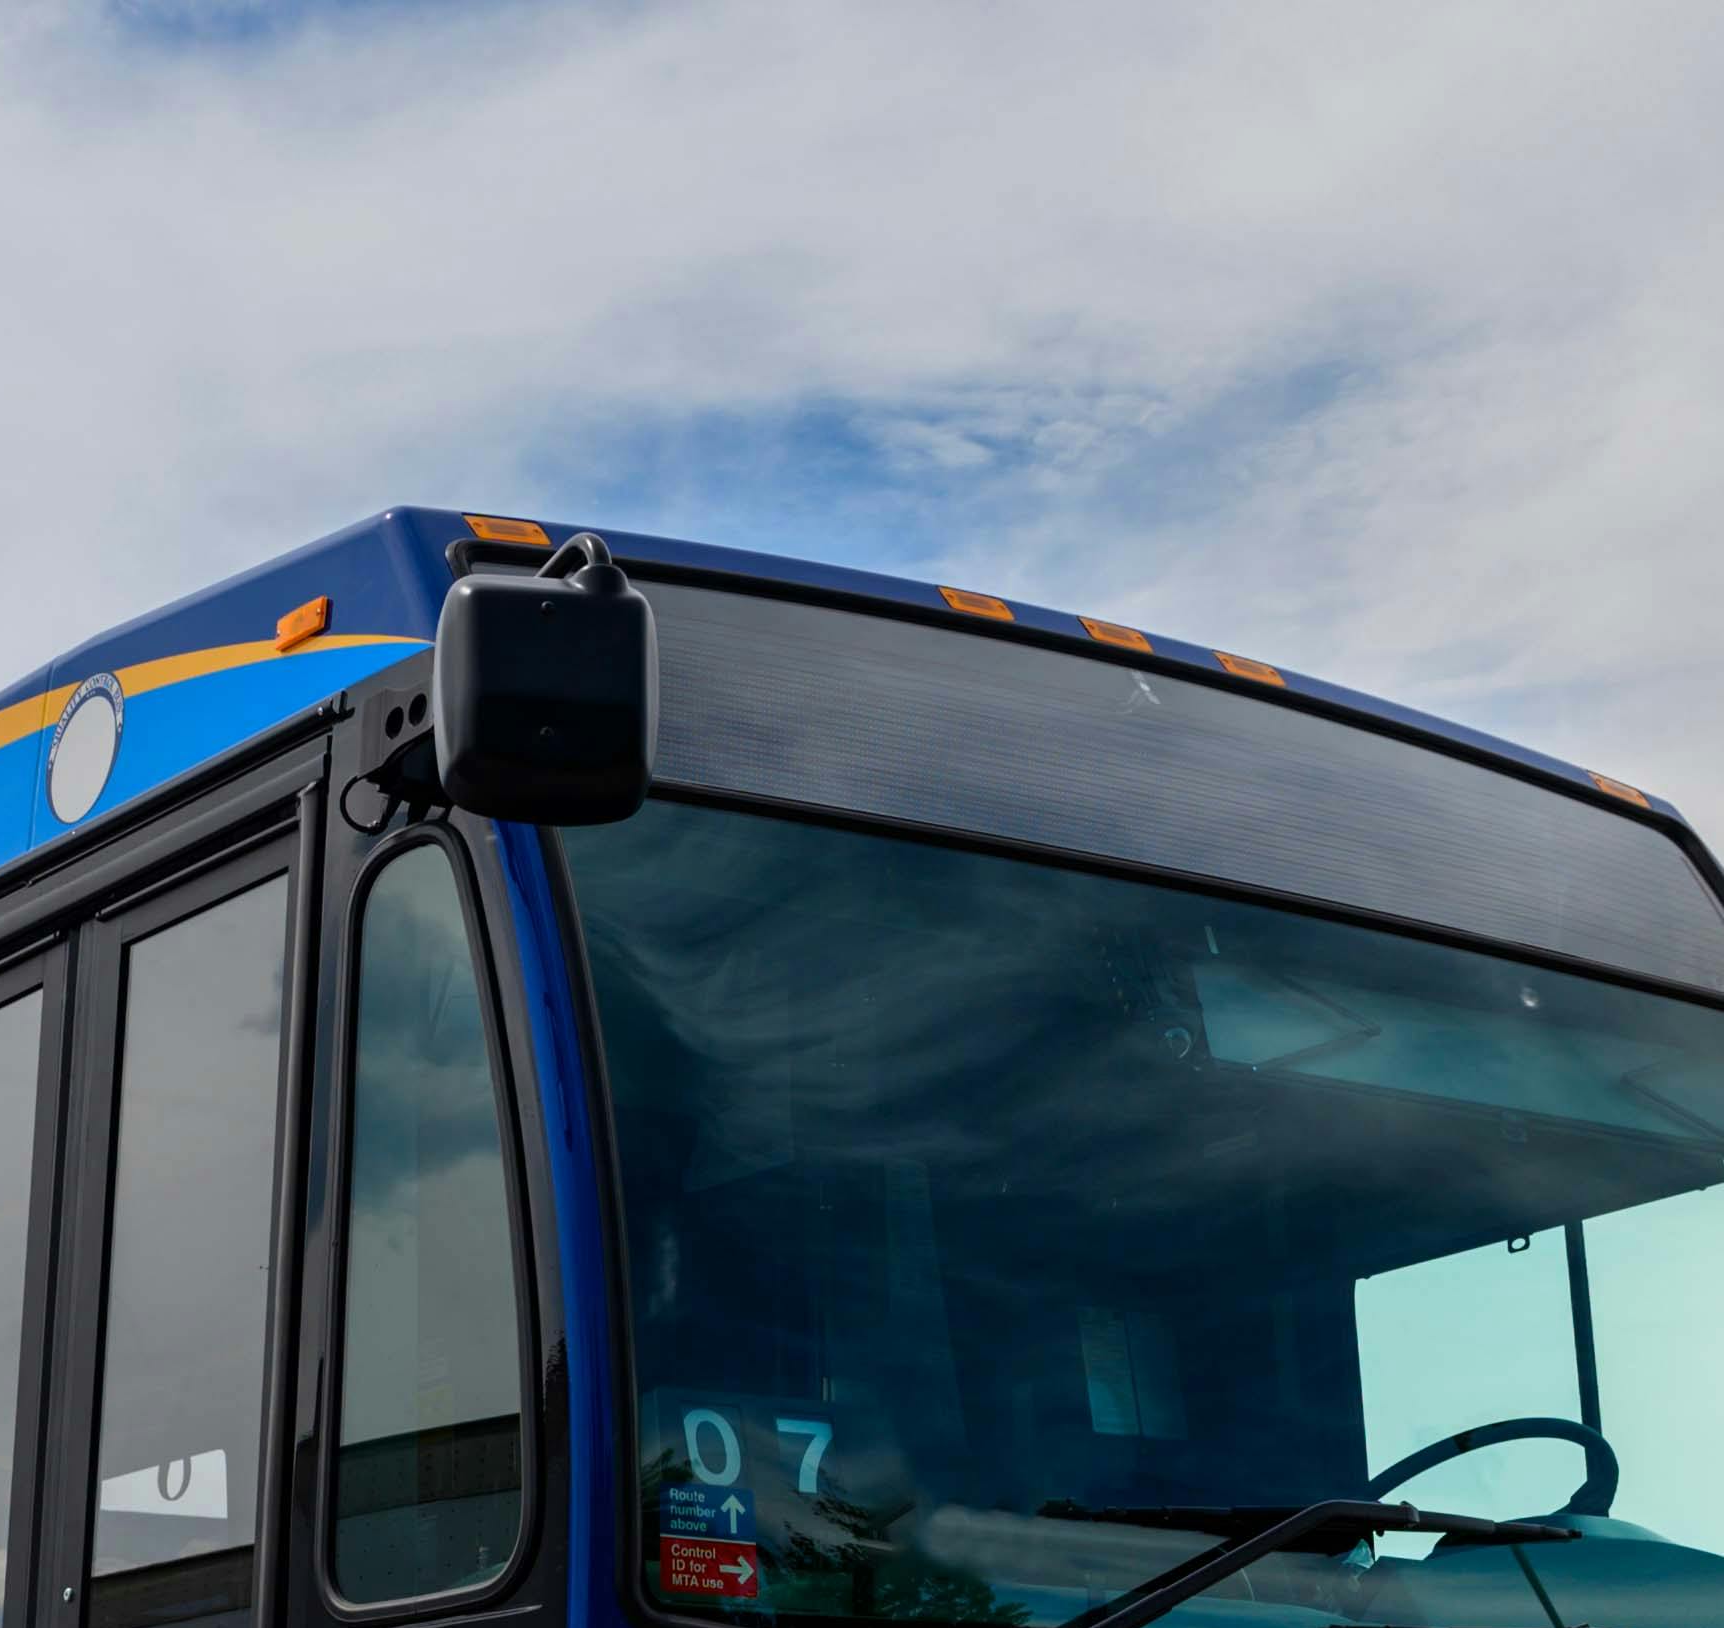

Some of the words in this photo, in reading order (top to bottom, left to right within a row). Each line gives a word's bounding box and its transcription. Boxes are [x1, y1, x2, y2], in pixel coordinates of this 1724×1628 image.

[776, 1417, 834, 1494] 7
[669, 1487, 706, 1503] Route
[670, 1504, 717, 1519] number
[670, 1517, 708, 1532] above
[671, 1543, 717, 1560] Control
[671, 1558, 686, 1572] ID
[689, 1559, 708, 1574] for
[671, 1573, 700, 1587] MTA
[702, 1577, 725, 1590] use
